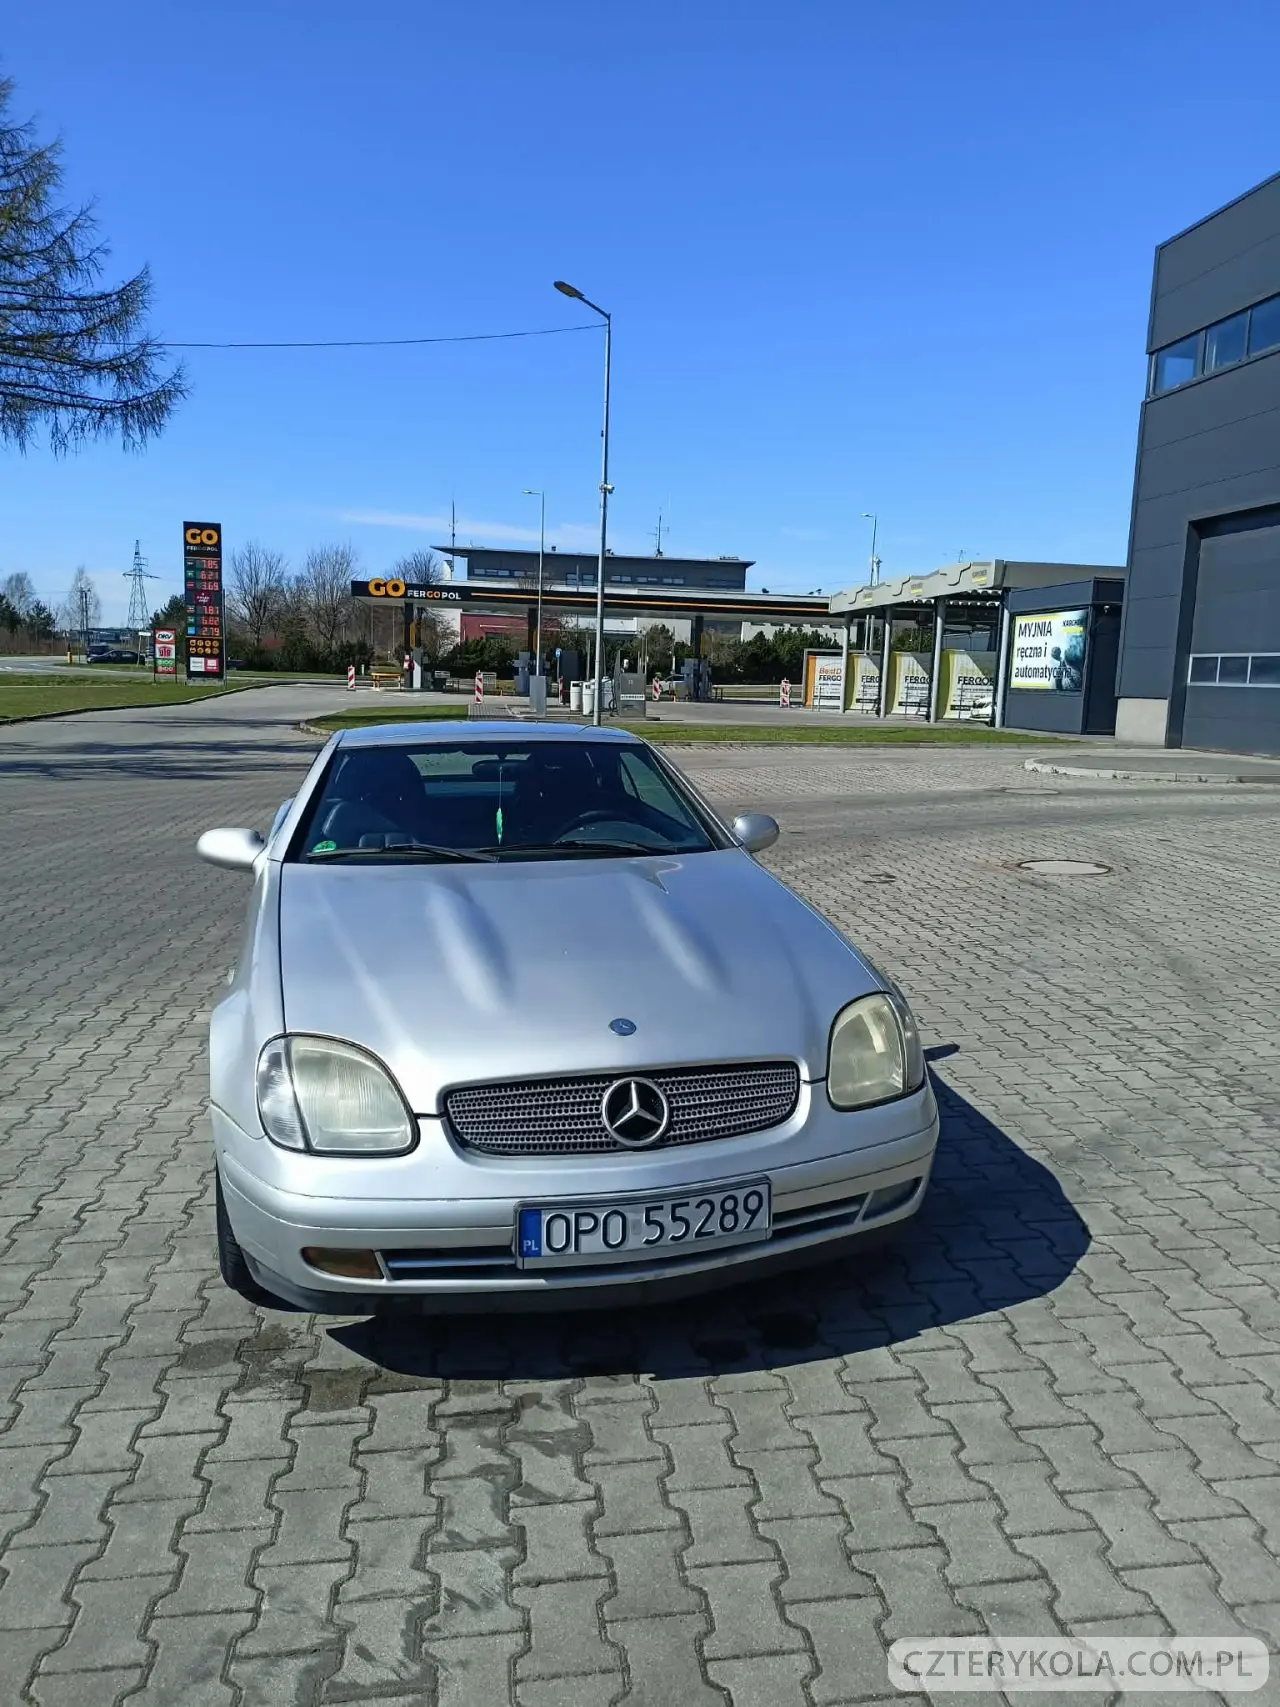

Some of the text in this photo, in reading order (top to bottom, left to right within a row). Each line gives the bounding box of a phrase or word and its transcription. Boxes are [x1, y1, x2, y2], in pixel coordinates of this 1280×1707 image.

[185, 528, 219, 545] GO
[368, 578, 406, 597] GO
[407, 590, 462, 600] FERGOPOL
[1018, 621, 1053, 638] MYJNIA
[1017, 642, 1048, 661] ręczna i
[819, 667, 842, 675] BestD
[861, 675, 880, 683] FERG
[1014, 664, 1072, 682] automatyczna
[545, 1189, 764, 1253] OPO 55289
[522, 1239, 540, 1251] PL
